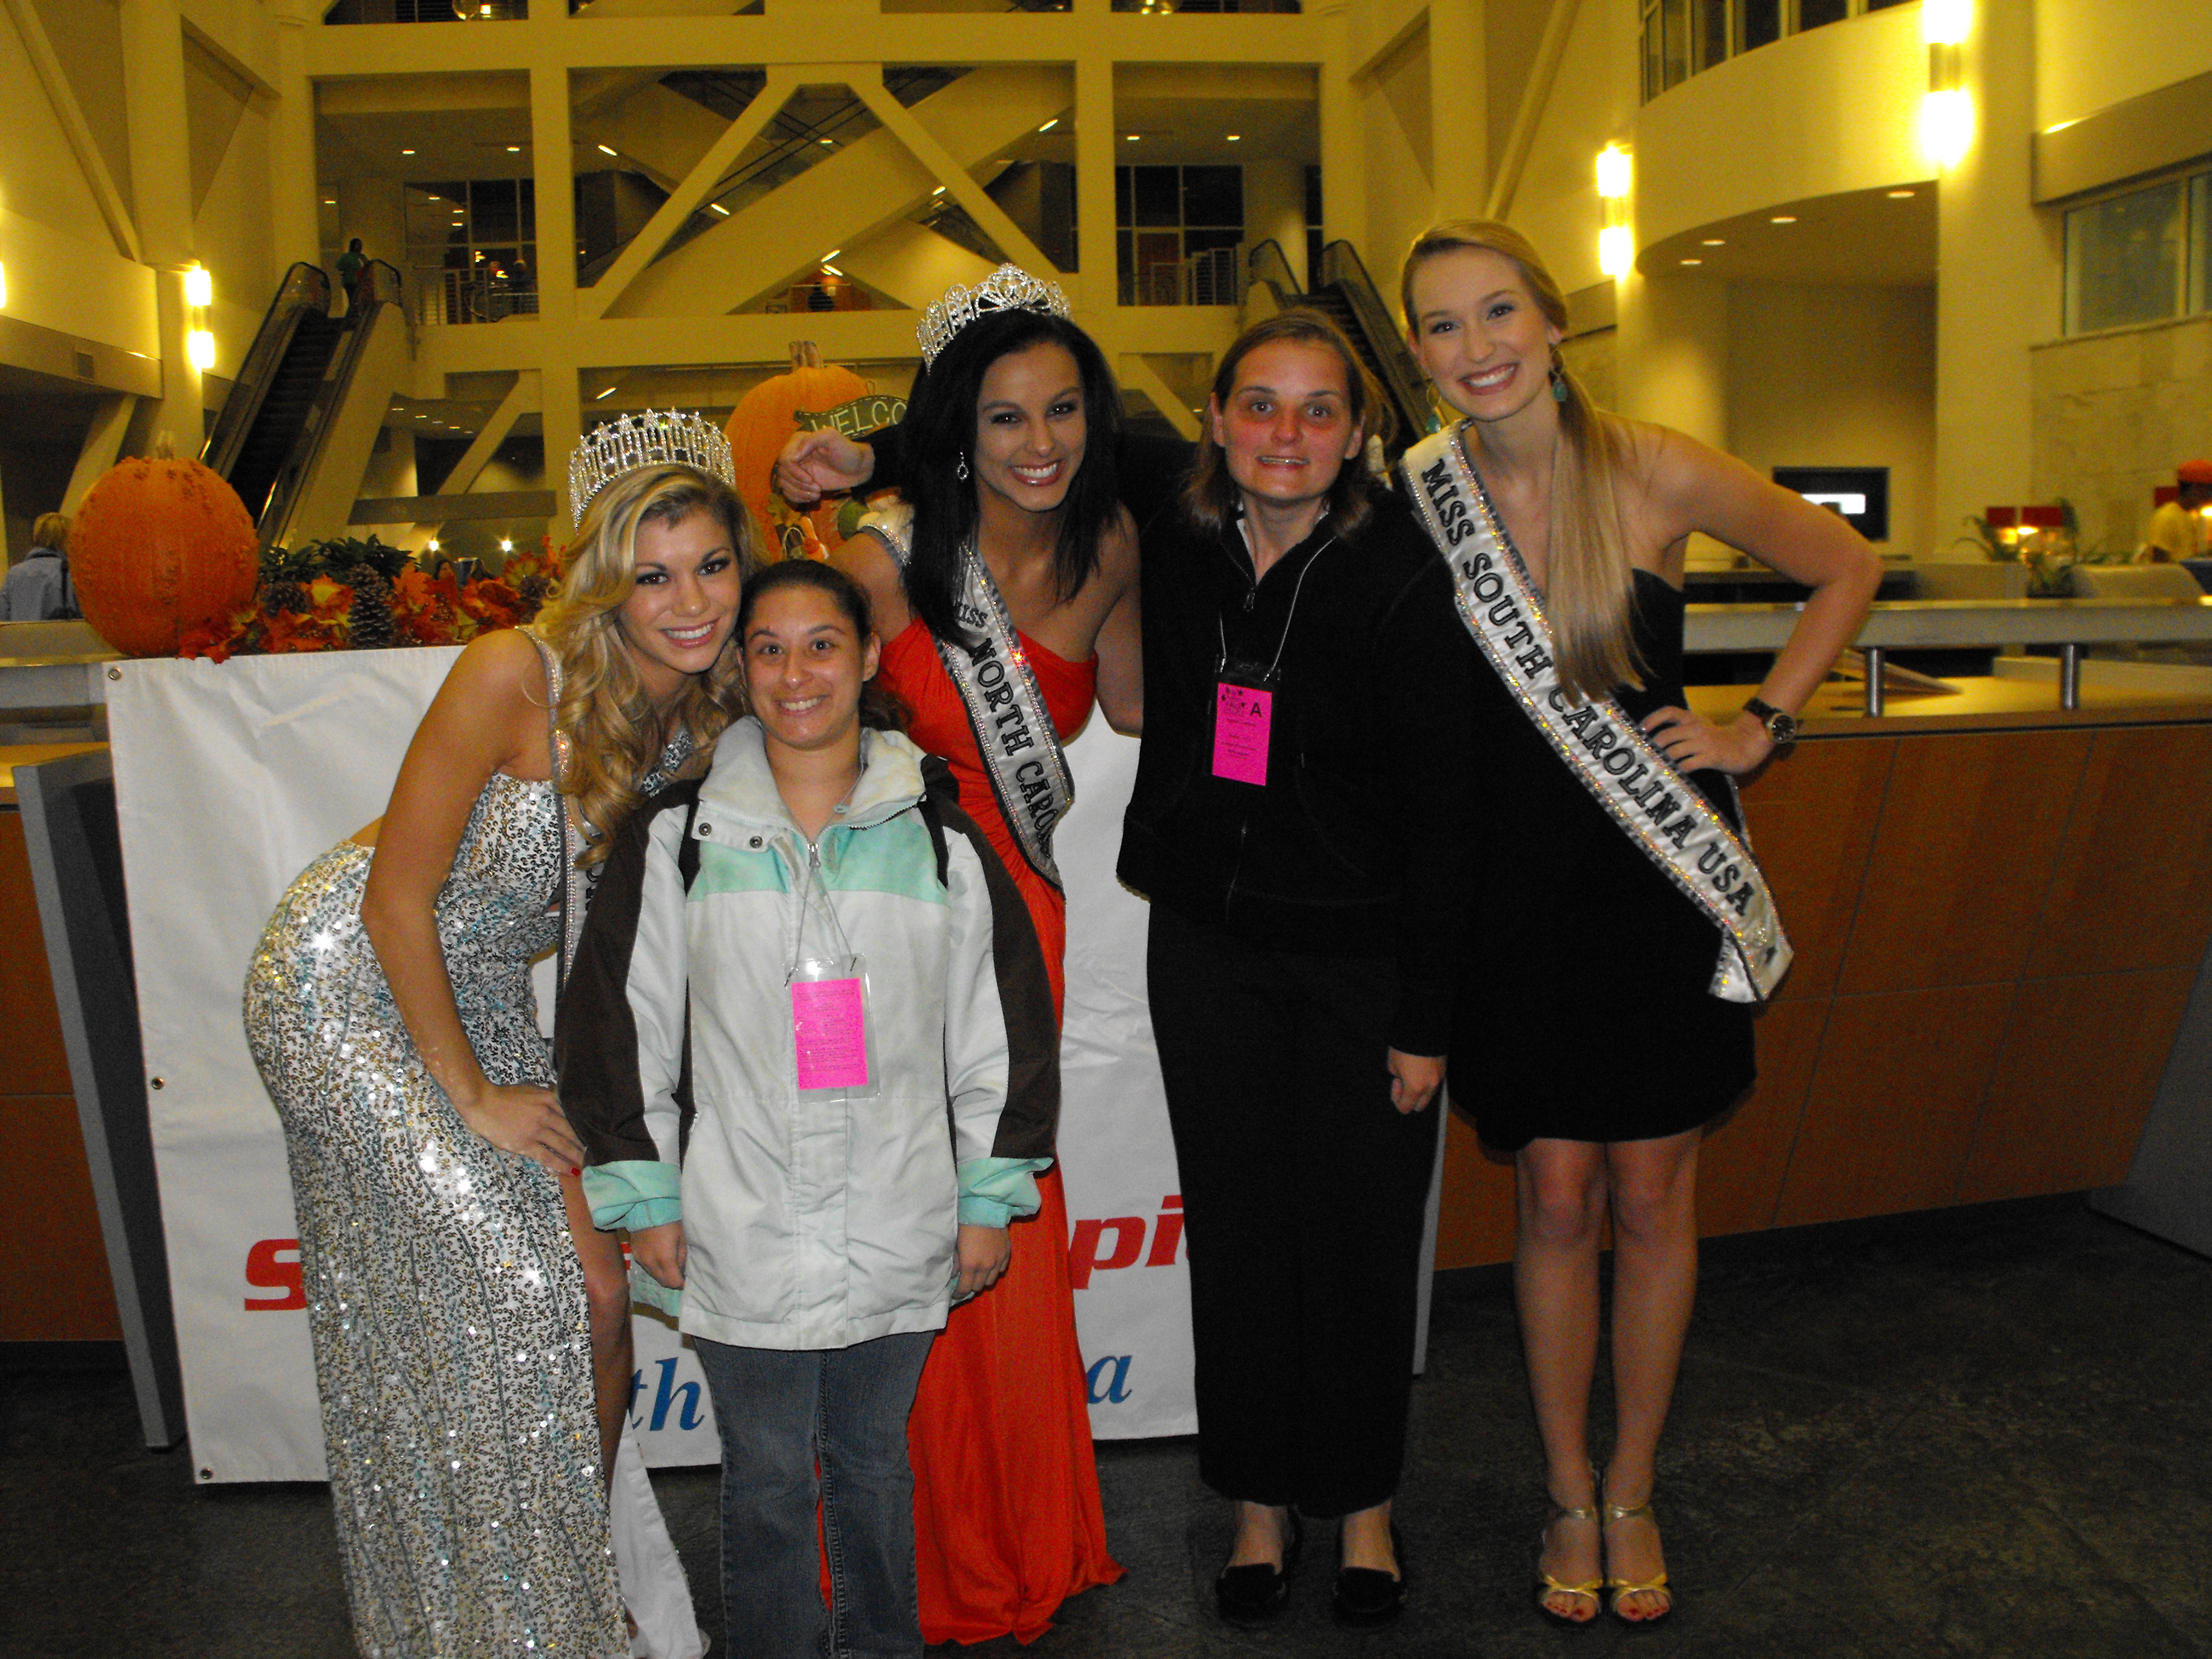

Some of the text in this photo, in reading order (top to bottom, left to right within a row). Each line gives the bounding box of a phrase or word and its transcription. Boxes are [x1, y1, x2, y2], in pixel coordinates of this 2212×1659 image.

[970, 637, 1034, 757] NORTH
[1250, 701, 1262, 718] A
[1421, 459, 1754, 916] MISS SOUTH CAROLINA USA
